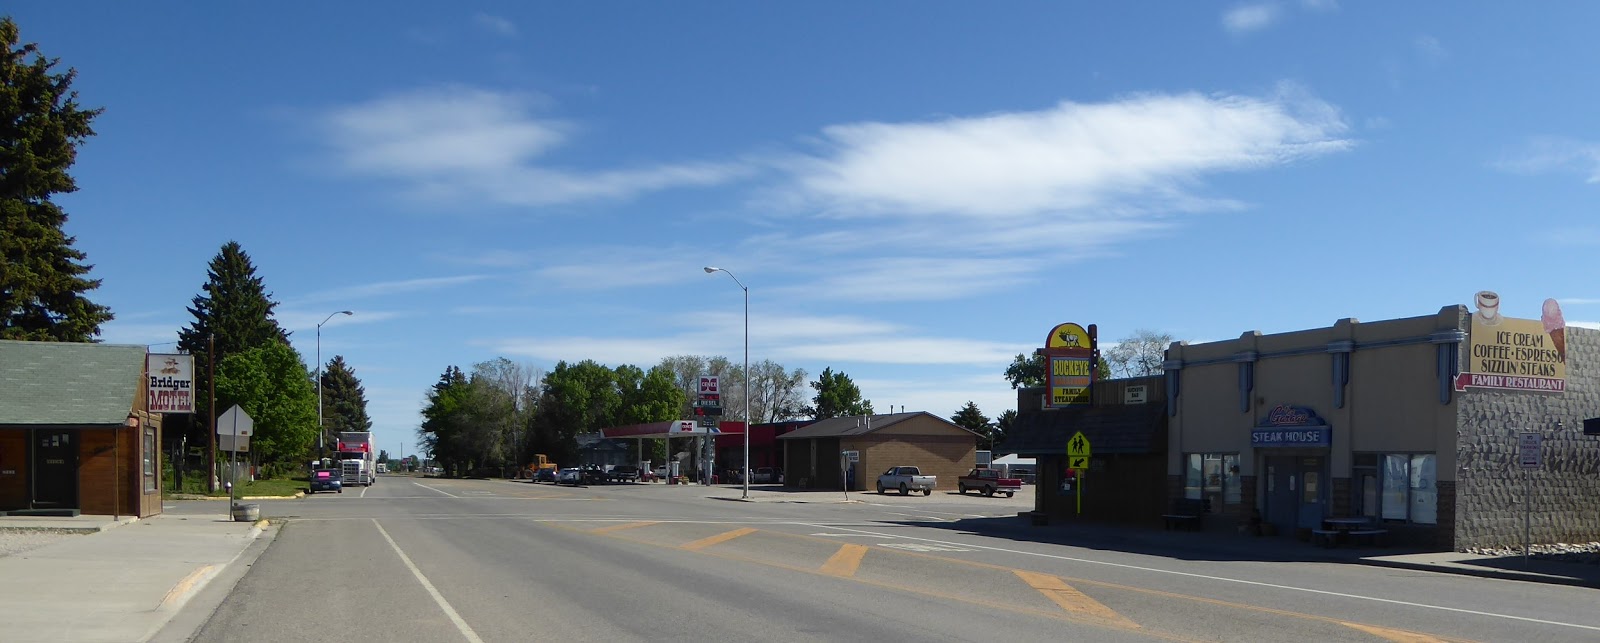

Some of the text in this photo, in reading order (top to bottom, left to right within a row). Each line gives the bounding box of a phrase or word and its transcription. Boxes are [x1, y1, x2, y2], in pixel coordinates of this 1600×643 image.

[1496, 331, 1543, 347] ICE CREAM
[1474, 344, 1562, 363] COFFEE ESPRESSO
[1053, 360, 1089, 376] BUCKEYE
[1520, 362, 1556, 377] STEAKS
[150, 376, 191, 390] Bridger
[1471, 375, 1563, 390] FAMILY RESTAURANT
[150, 390, 191, 410] MOTEL
[1252, 431, 1320, 442] STEAK HOUSE
